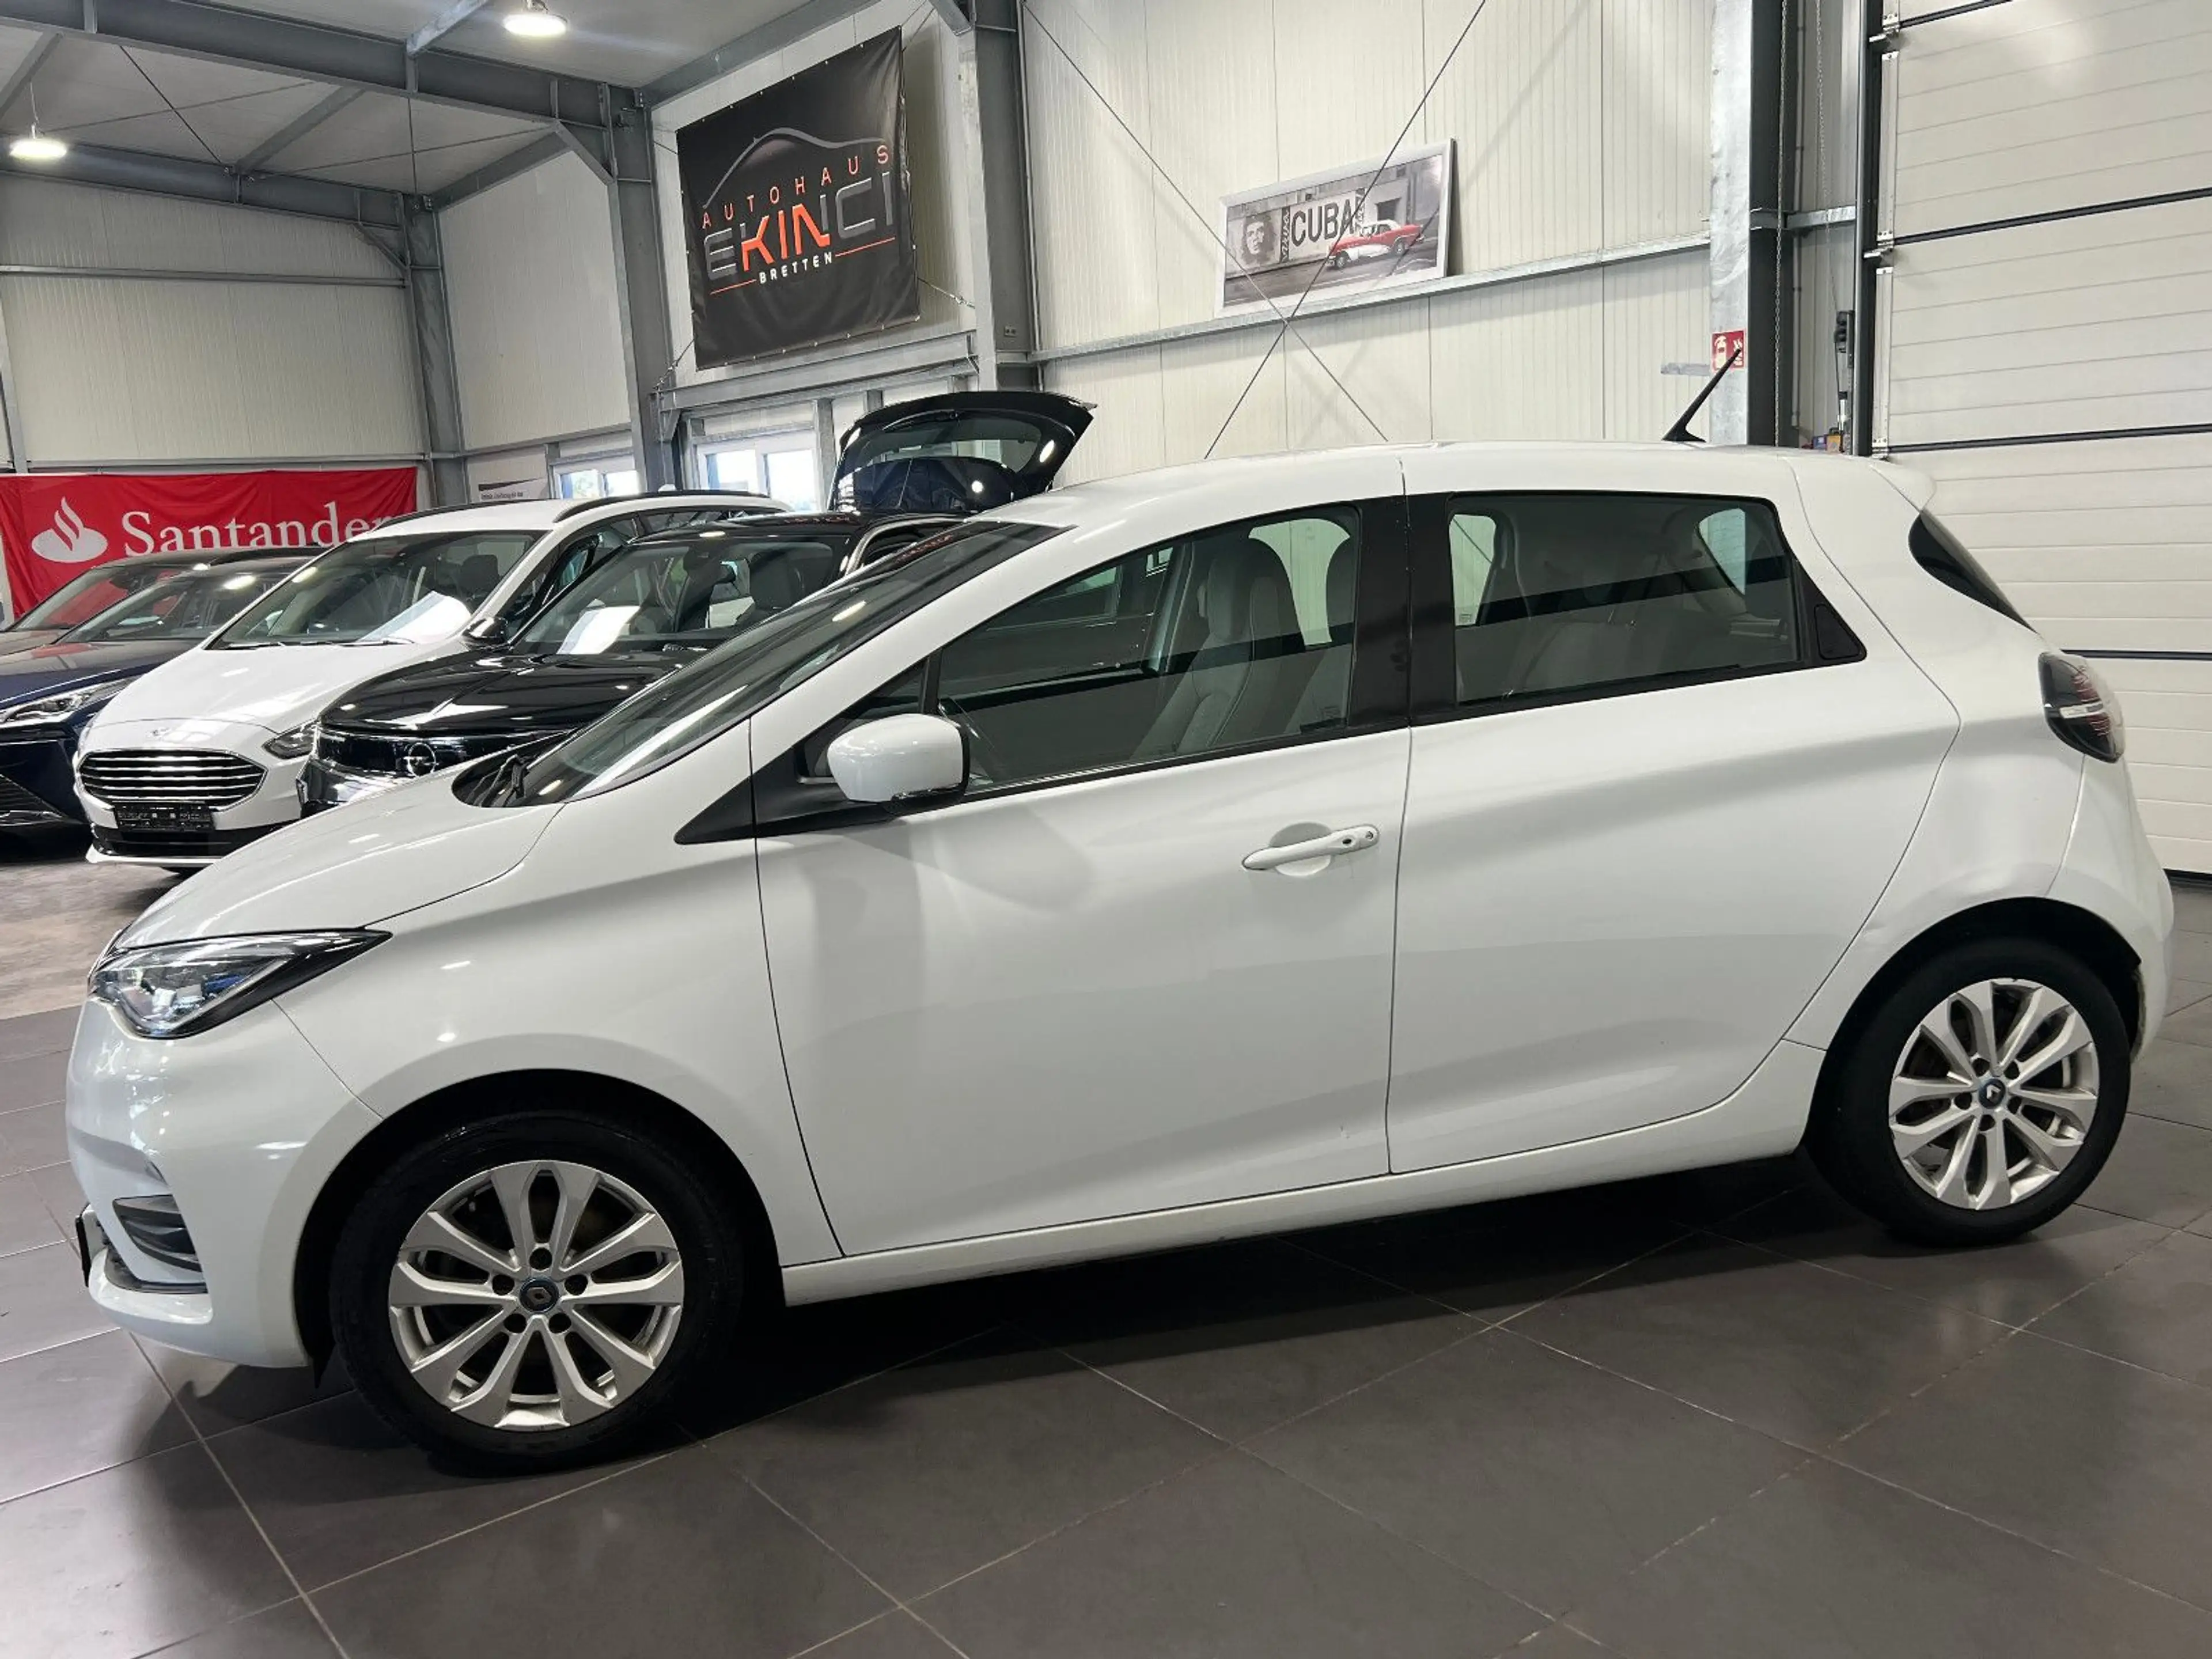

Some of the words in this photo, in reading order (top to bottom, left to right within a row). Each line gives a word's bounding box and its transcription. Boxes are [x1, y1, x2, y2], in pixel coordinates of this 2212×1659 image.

[702, 145, 889, 229] AUTOHAUS
[703, 172, 894, 281] EKINCI
[1291, 199, 1354, 247] CUBA
[759, 252, 832, 285] BRETTEN
